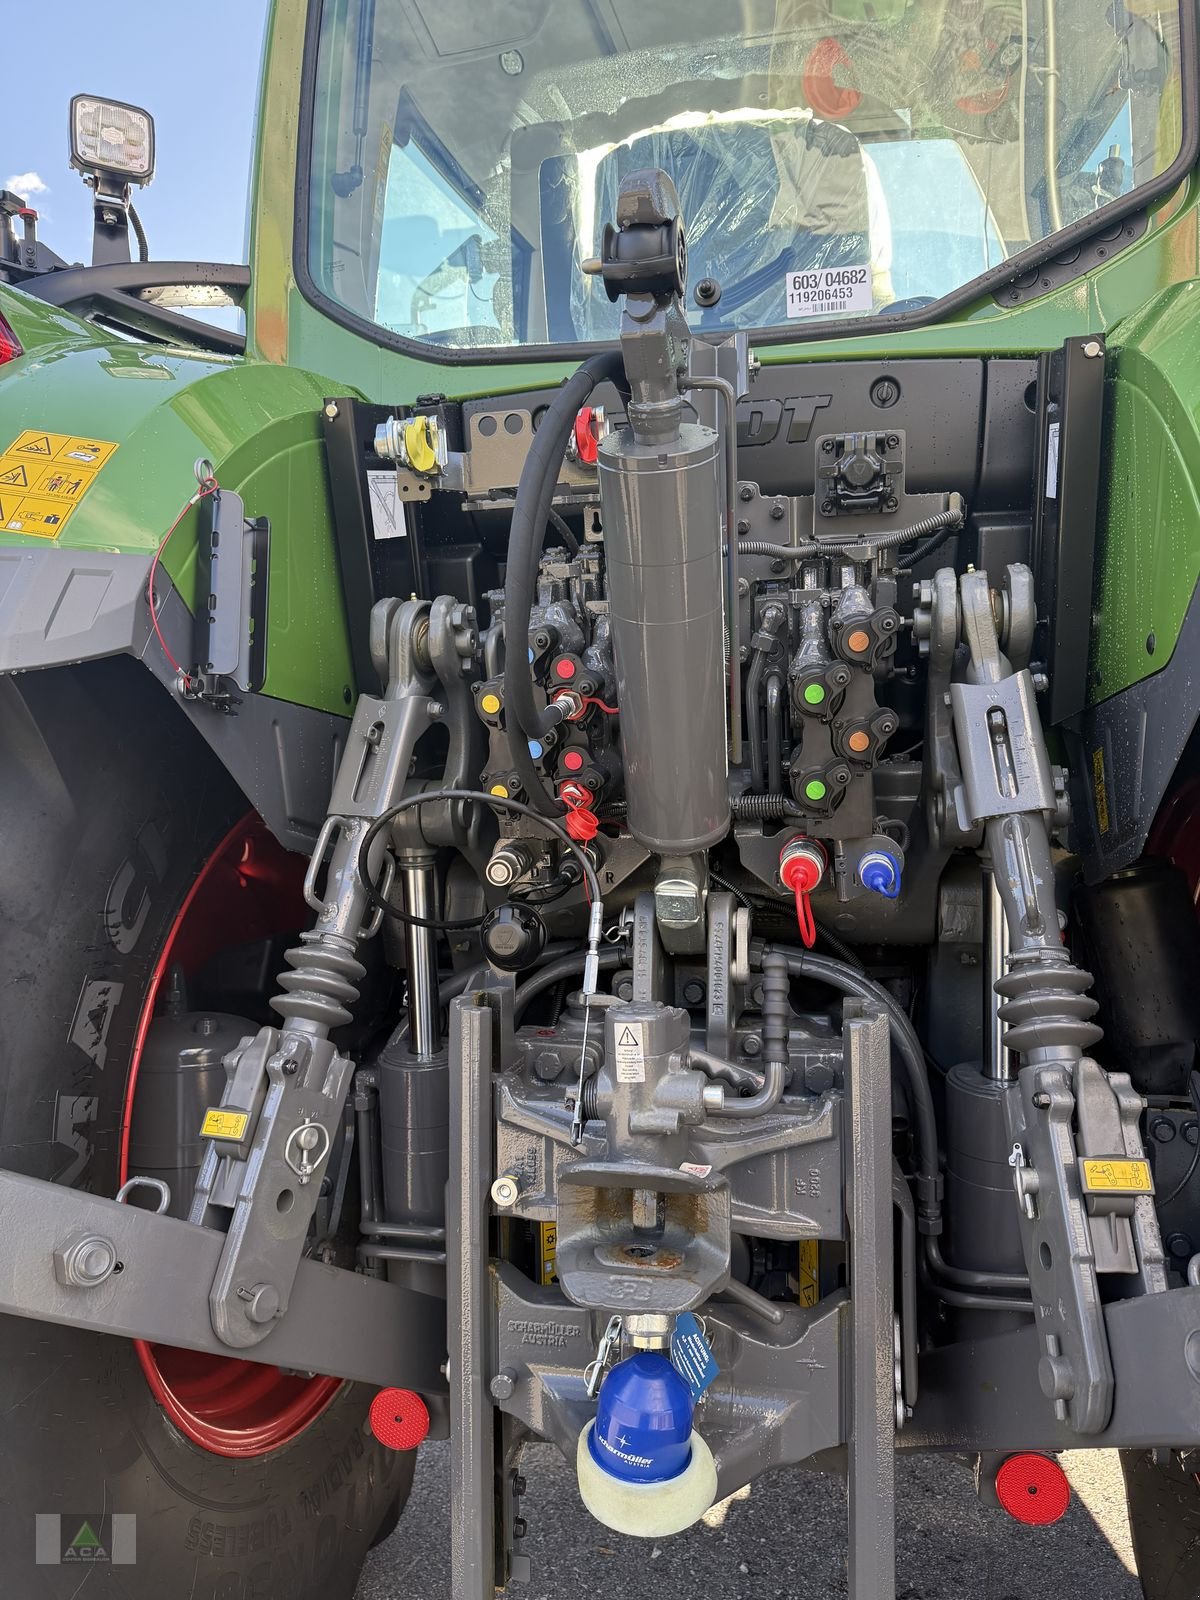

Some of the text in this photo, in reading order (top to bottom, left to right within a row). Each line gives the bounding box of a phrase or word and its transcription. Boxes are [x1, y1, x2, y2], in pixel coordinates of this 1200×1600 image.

[825, 269, 867, 287] 04682
[789, 287, 853, 304] 119206453
[521, 1333, 568, 1347] AUSTRIA
